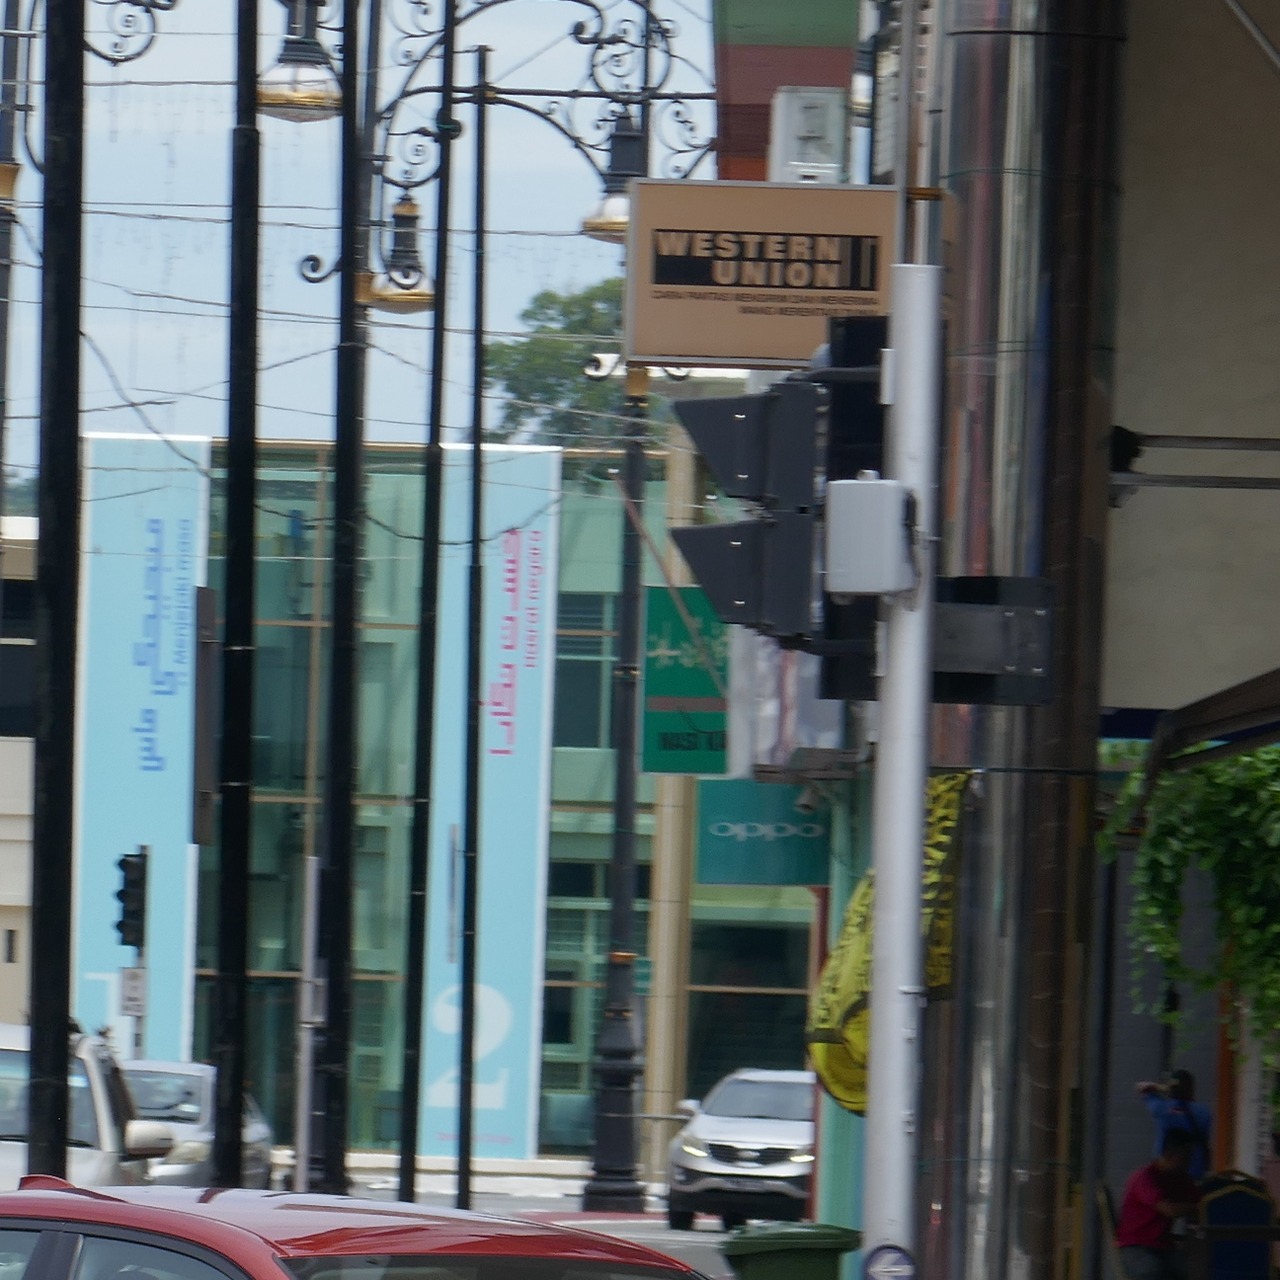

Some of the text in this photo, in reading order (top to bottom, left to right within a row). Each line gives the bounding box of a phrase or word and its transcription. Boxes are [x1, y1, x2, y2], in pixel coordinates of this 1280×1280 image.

[657, 231, 839, 259] WESTERN
[712, 261, 839, 286] UNION
[429, 982, 514, 1110] 2
